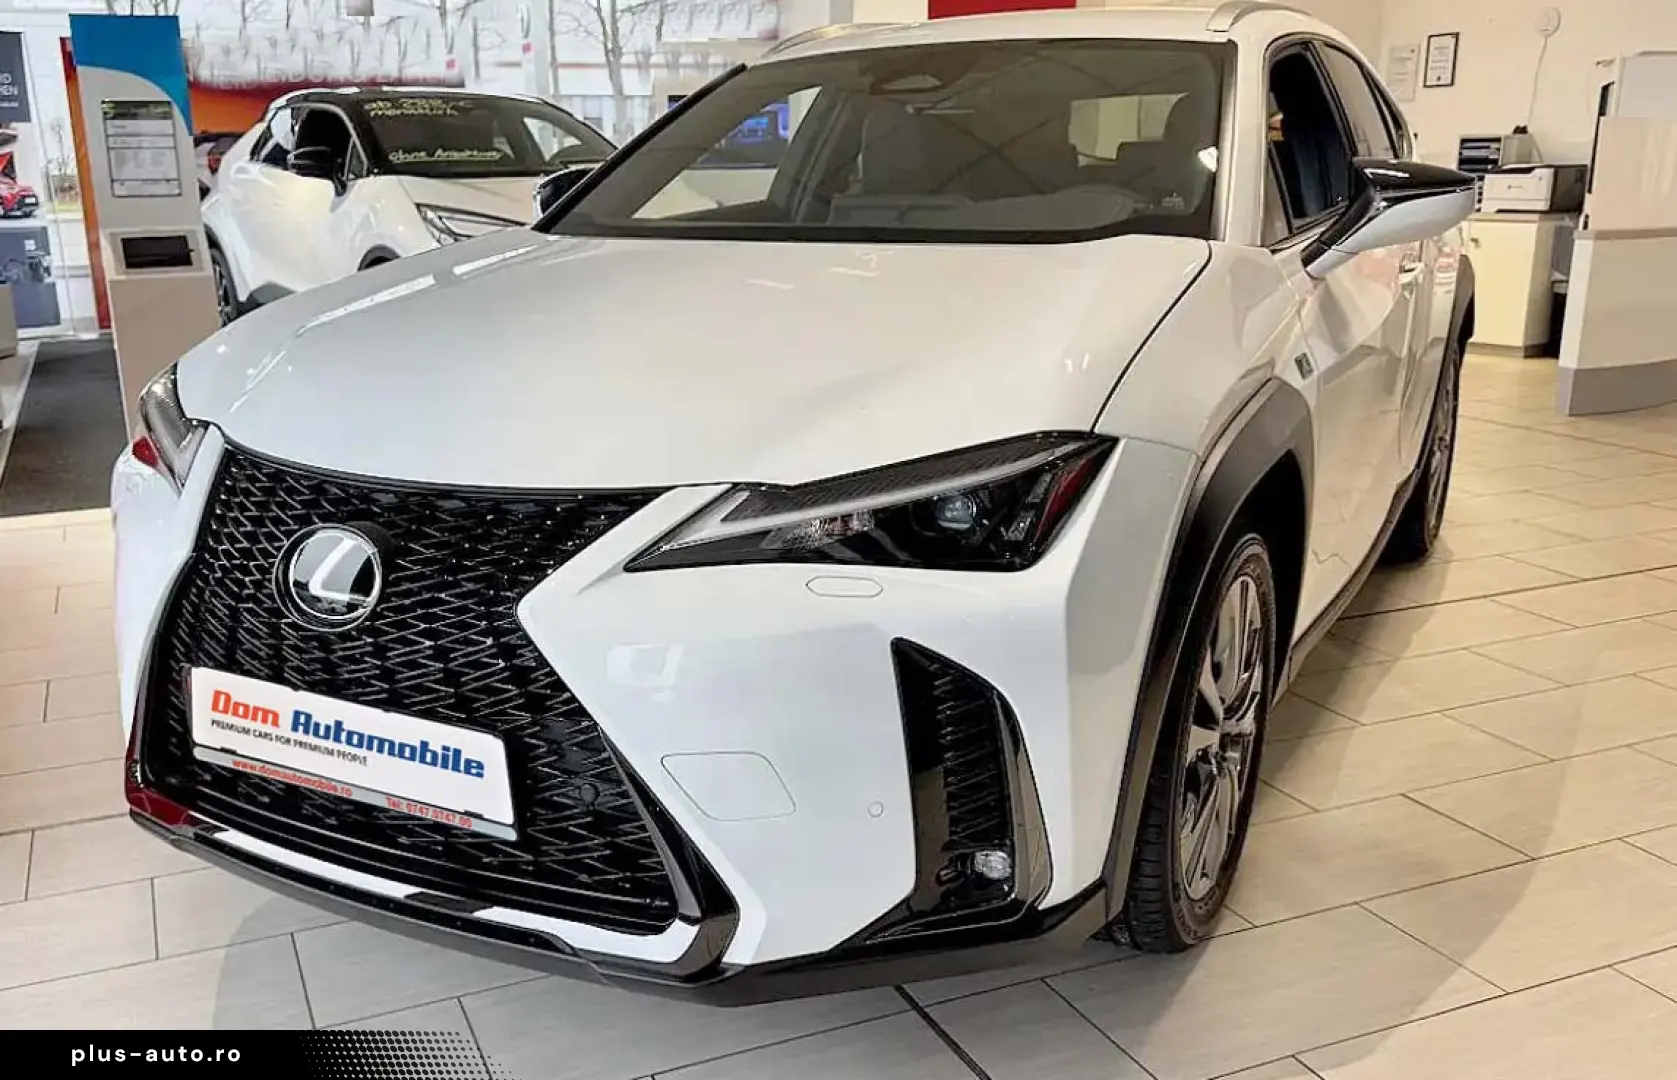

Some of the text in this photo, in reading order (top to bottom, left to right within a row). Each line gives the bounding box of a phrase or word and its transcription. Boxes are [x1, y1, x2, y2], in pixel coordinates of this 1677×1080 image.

[211, 689, 485, 779] Dom Automobile
[211, 719, 369, 767] PREMIUM CARS FOR PREMIUM PEOPLE
